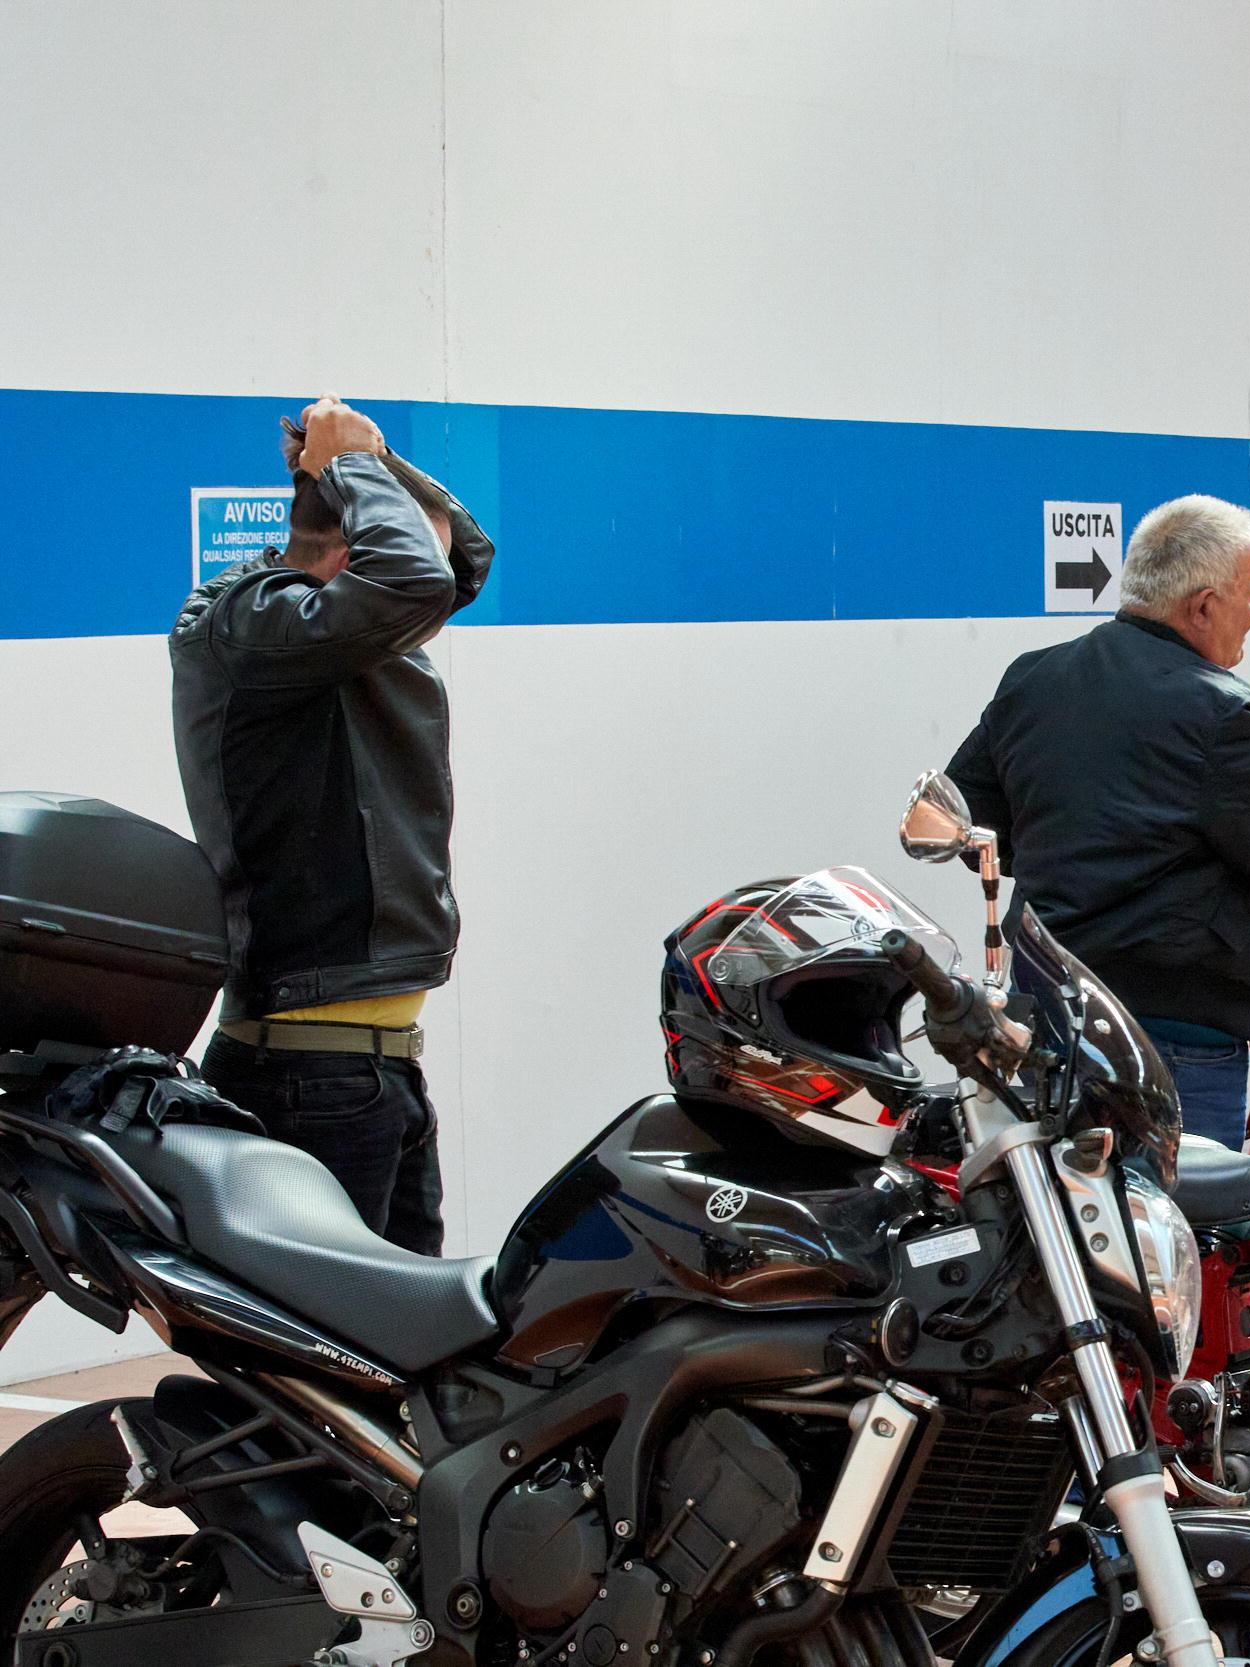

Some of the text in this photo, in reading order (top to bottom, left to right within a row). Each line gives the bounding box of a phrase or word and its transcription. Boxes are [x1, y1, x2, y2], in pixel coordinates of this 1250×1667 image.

[224, 502, 285, 523] AVVISO
[1052, 513, 1115, 538] USCITA
[212, 531, 290, 545] LA DIREZIONE DECLI
[202, 550, 243, 562] QUALSIASI
[315, 1342, 393, 1387] WWW.4TEMPI.COM
